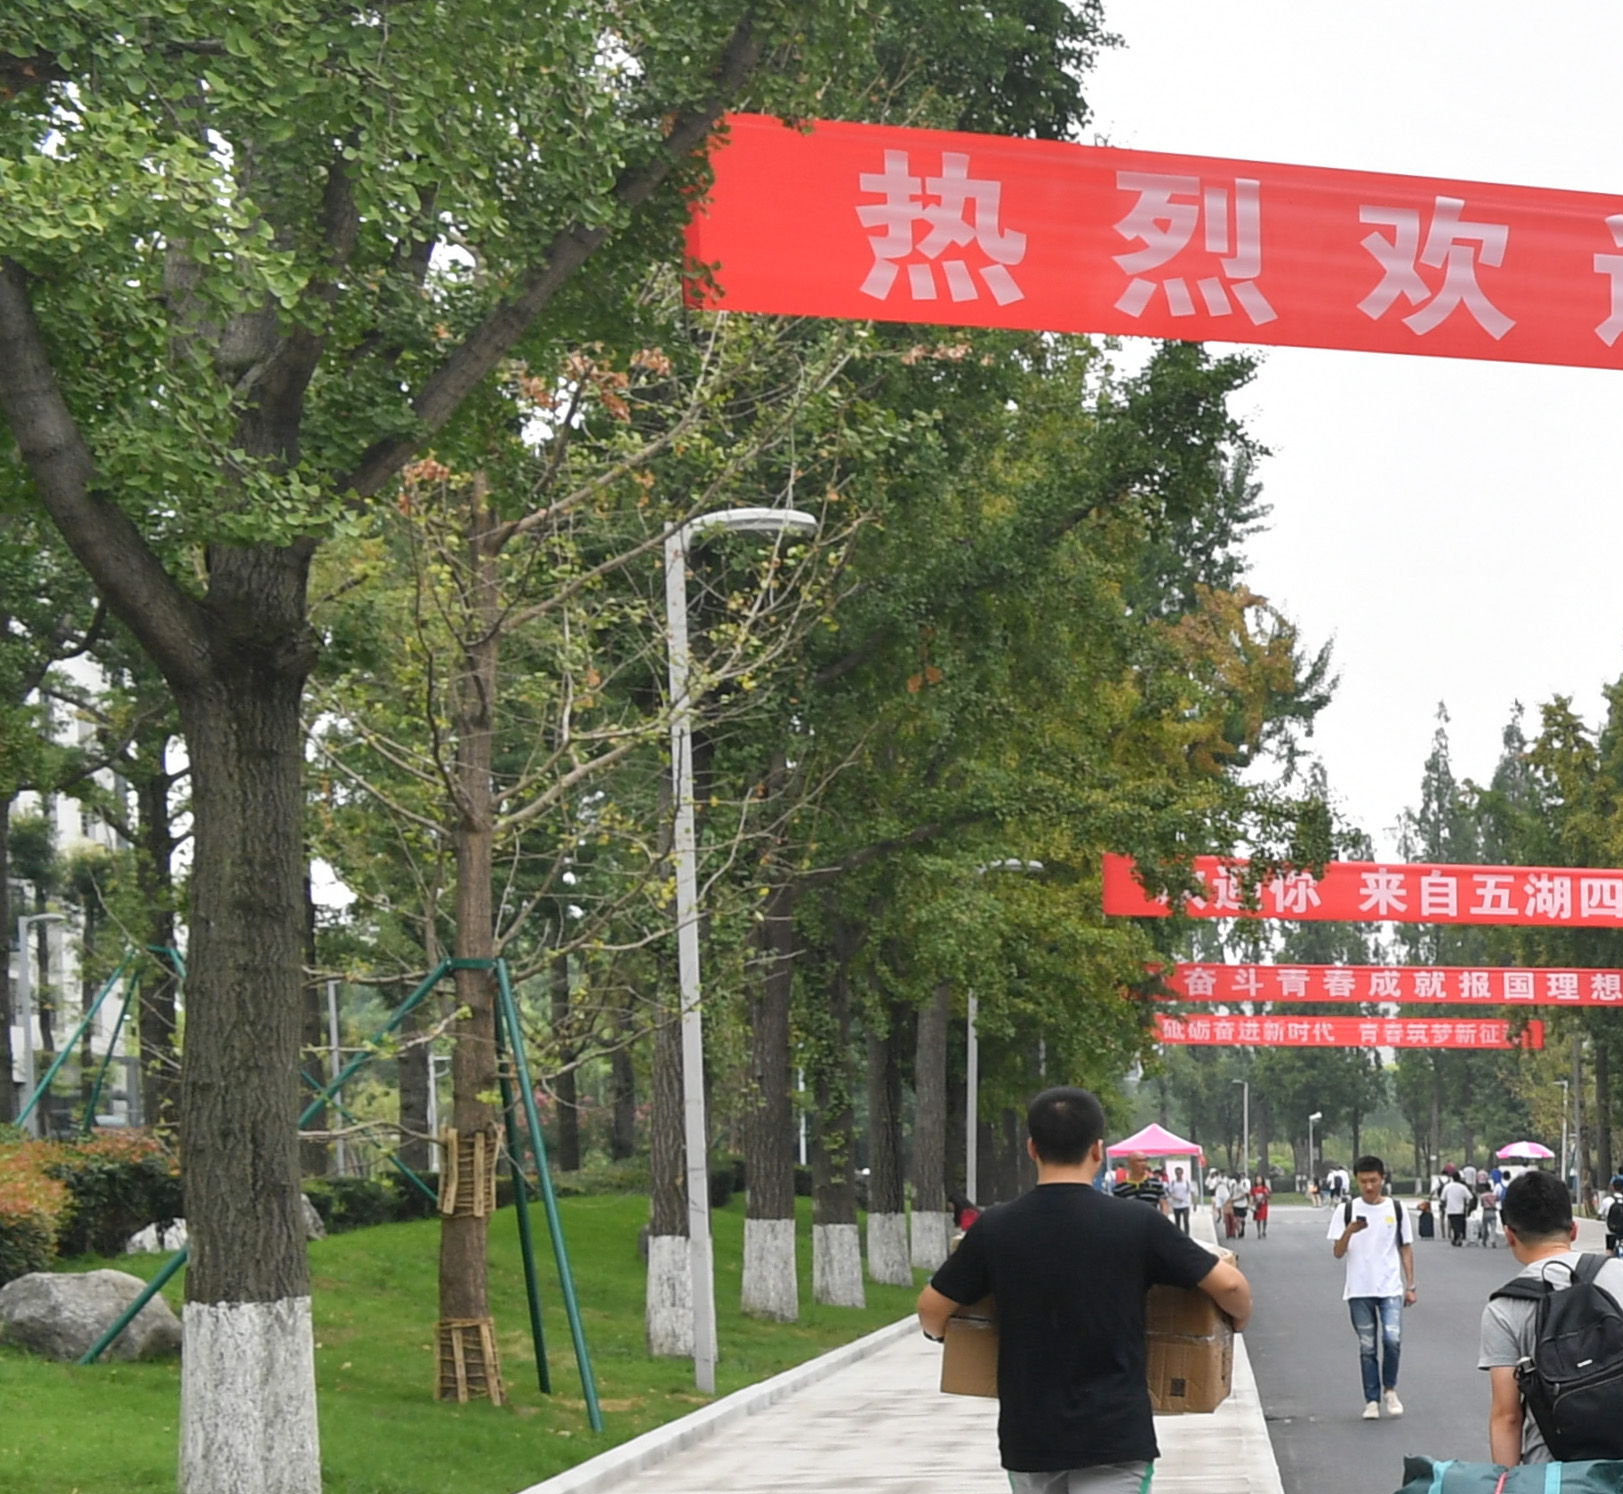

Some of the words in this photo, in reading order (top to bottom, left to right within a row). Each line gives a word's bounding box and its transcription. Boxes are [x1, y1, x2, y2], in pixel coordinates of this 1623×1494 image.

[1184, 967, 1623, 1001] 奋斗青春成就报国理想
[1162, 1018, 1336, 1042] 砥砺奋进新时代
[1358, 1022, 1526, 1046] 青春筑梦新征
